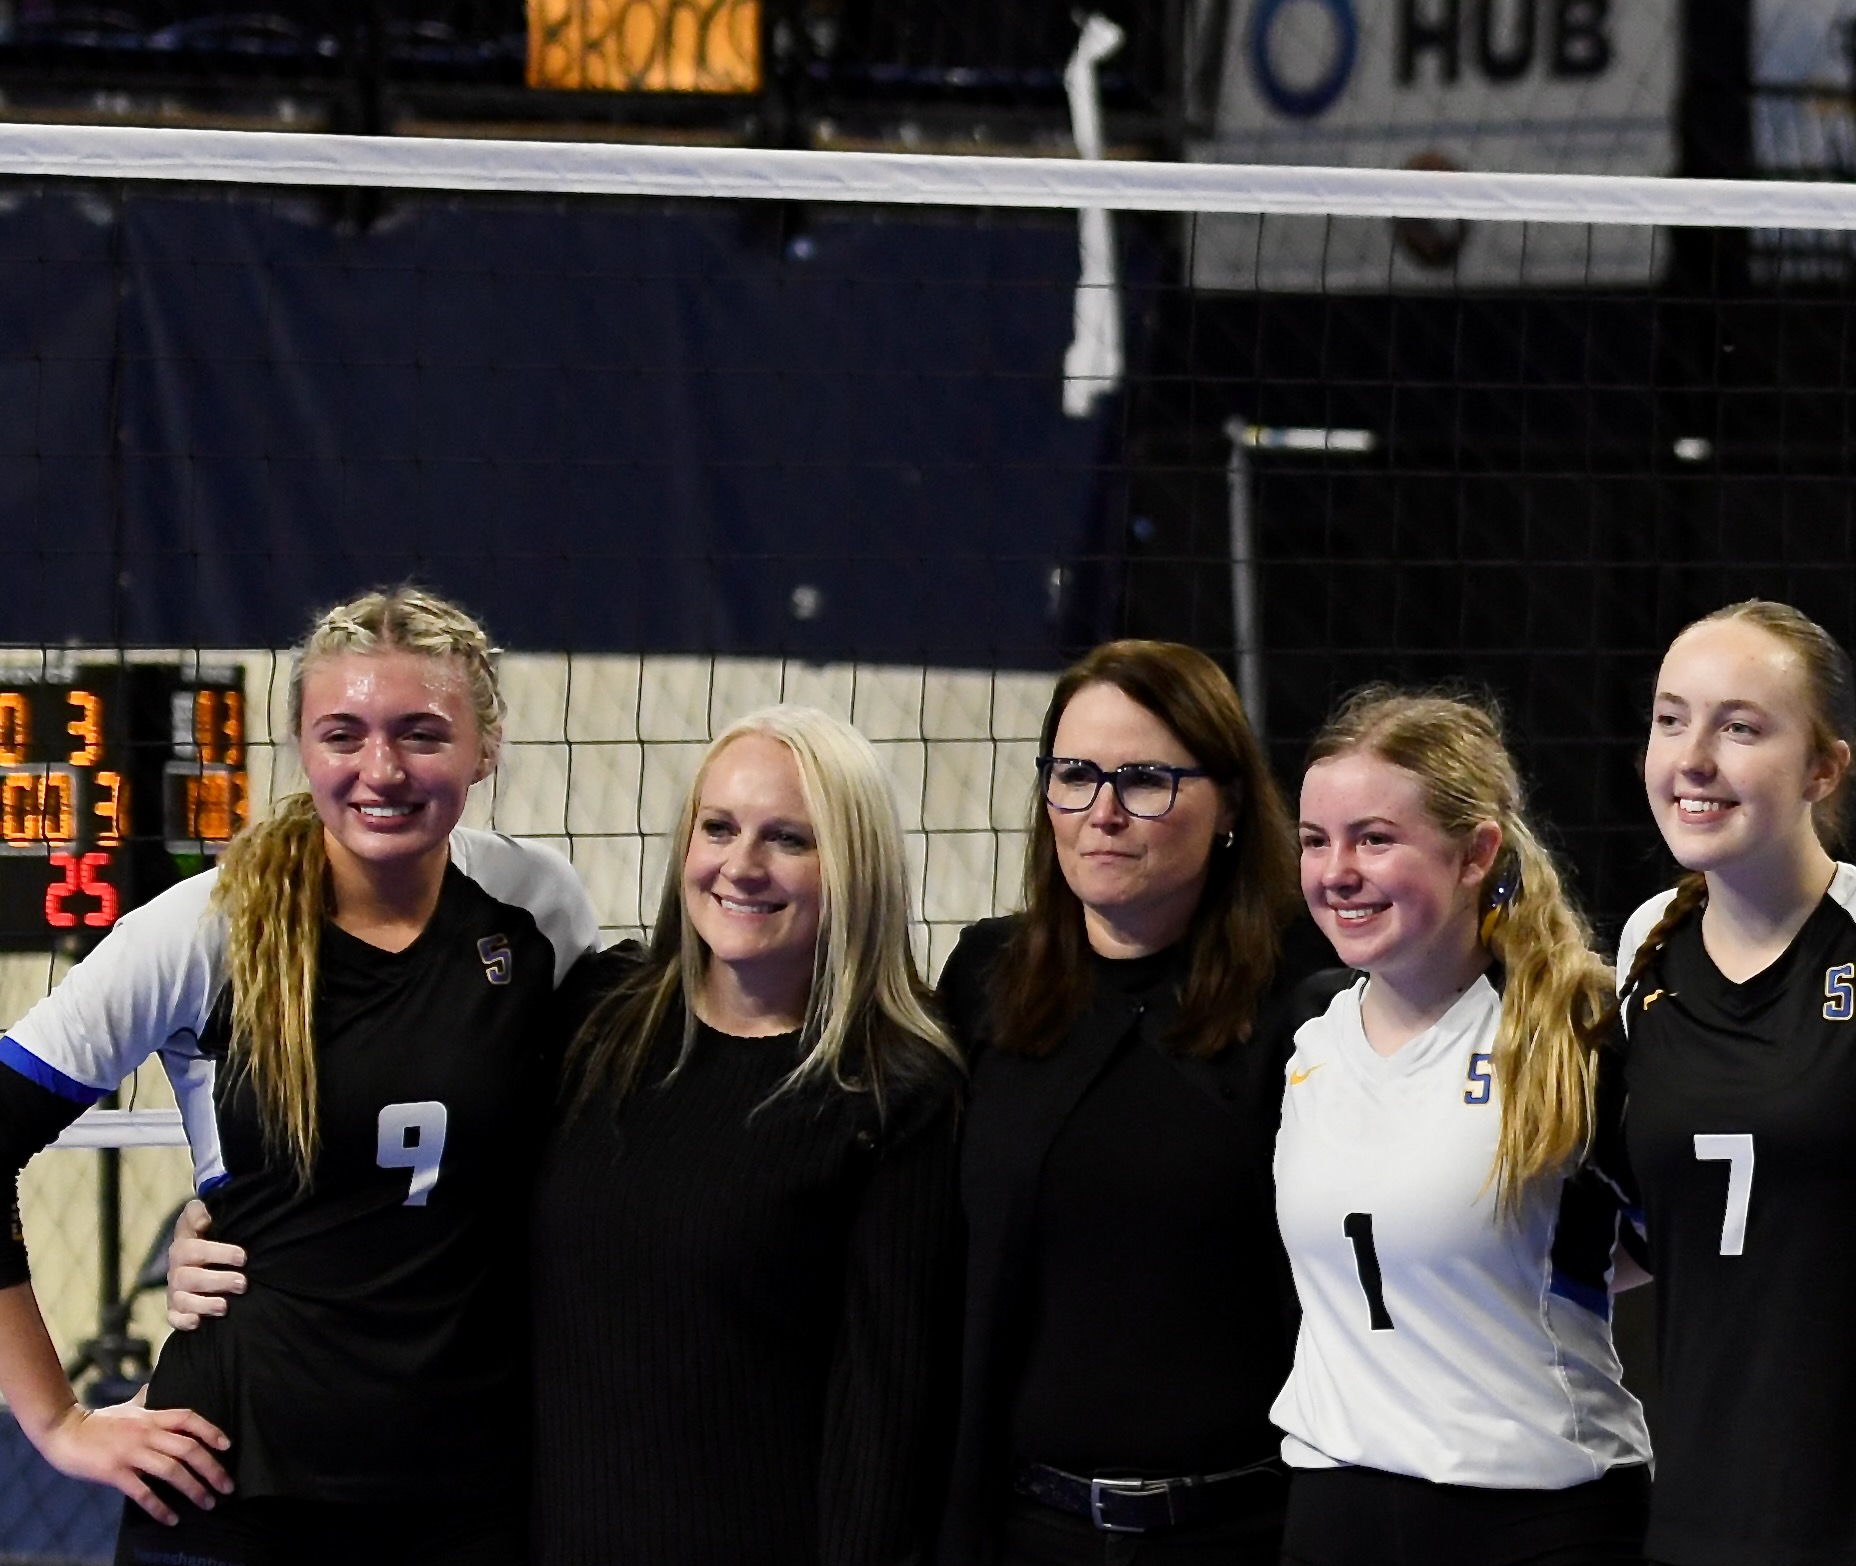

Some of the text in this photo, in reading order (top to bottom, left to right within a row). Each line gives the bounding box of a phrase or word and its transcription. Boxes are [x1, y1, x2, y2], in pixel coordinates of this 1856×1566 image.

[1397, 0, 1612, 83] HUB
[1822, 962, 1856, 1021] S
[376, 1101, 448, 1207] 9
[1693, 1133, 1755, 1256] 7
[1343, 1212, 1395, 1331] 1
